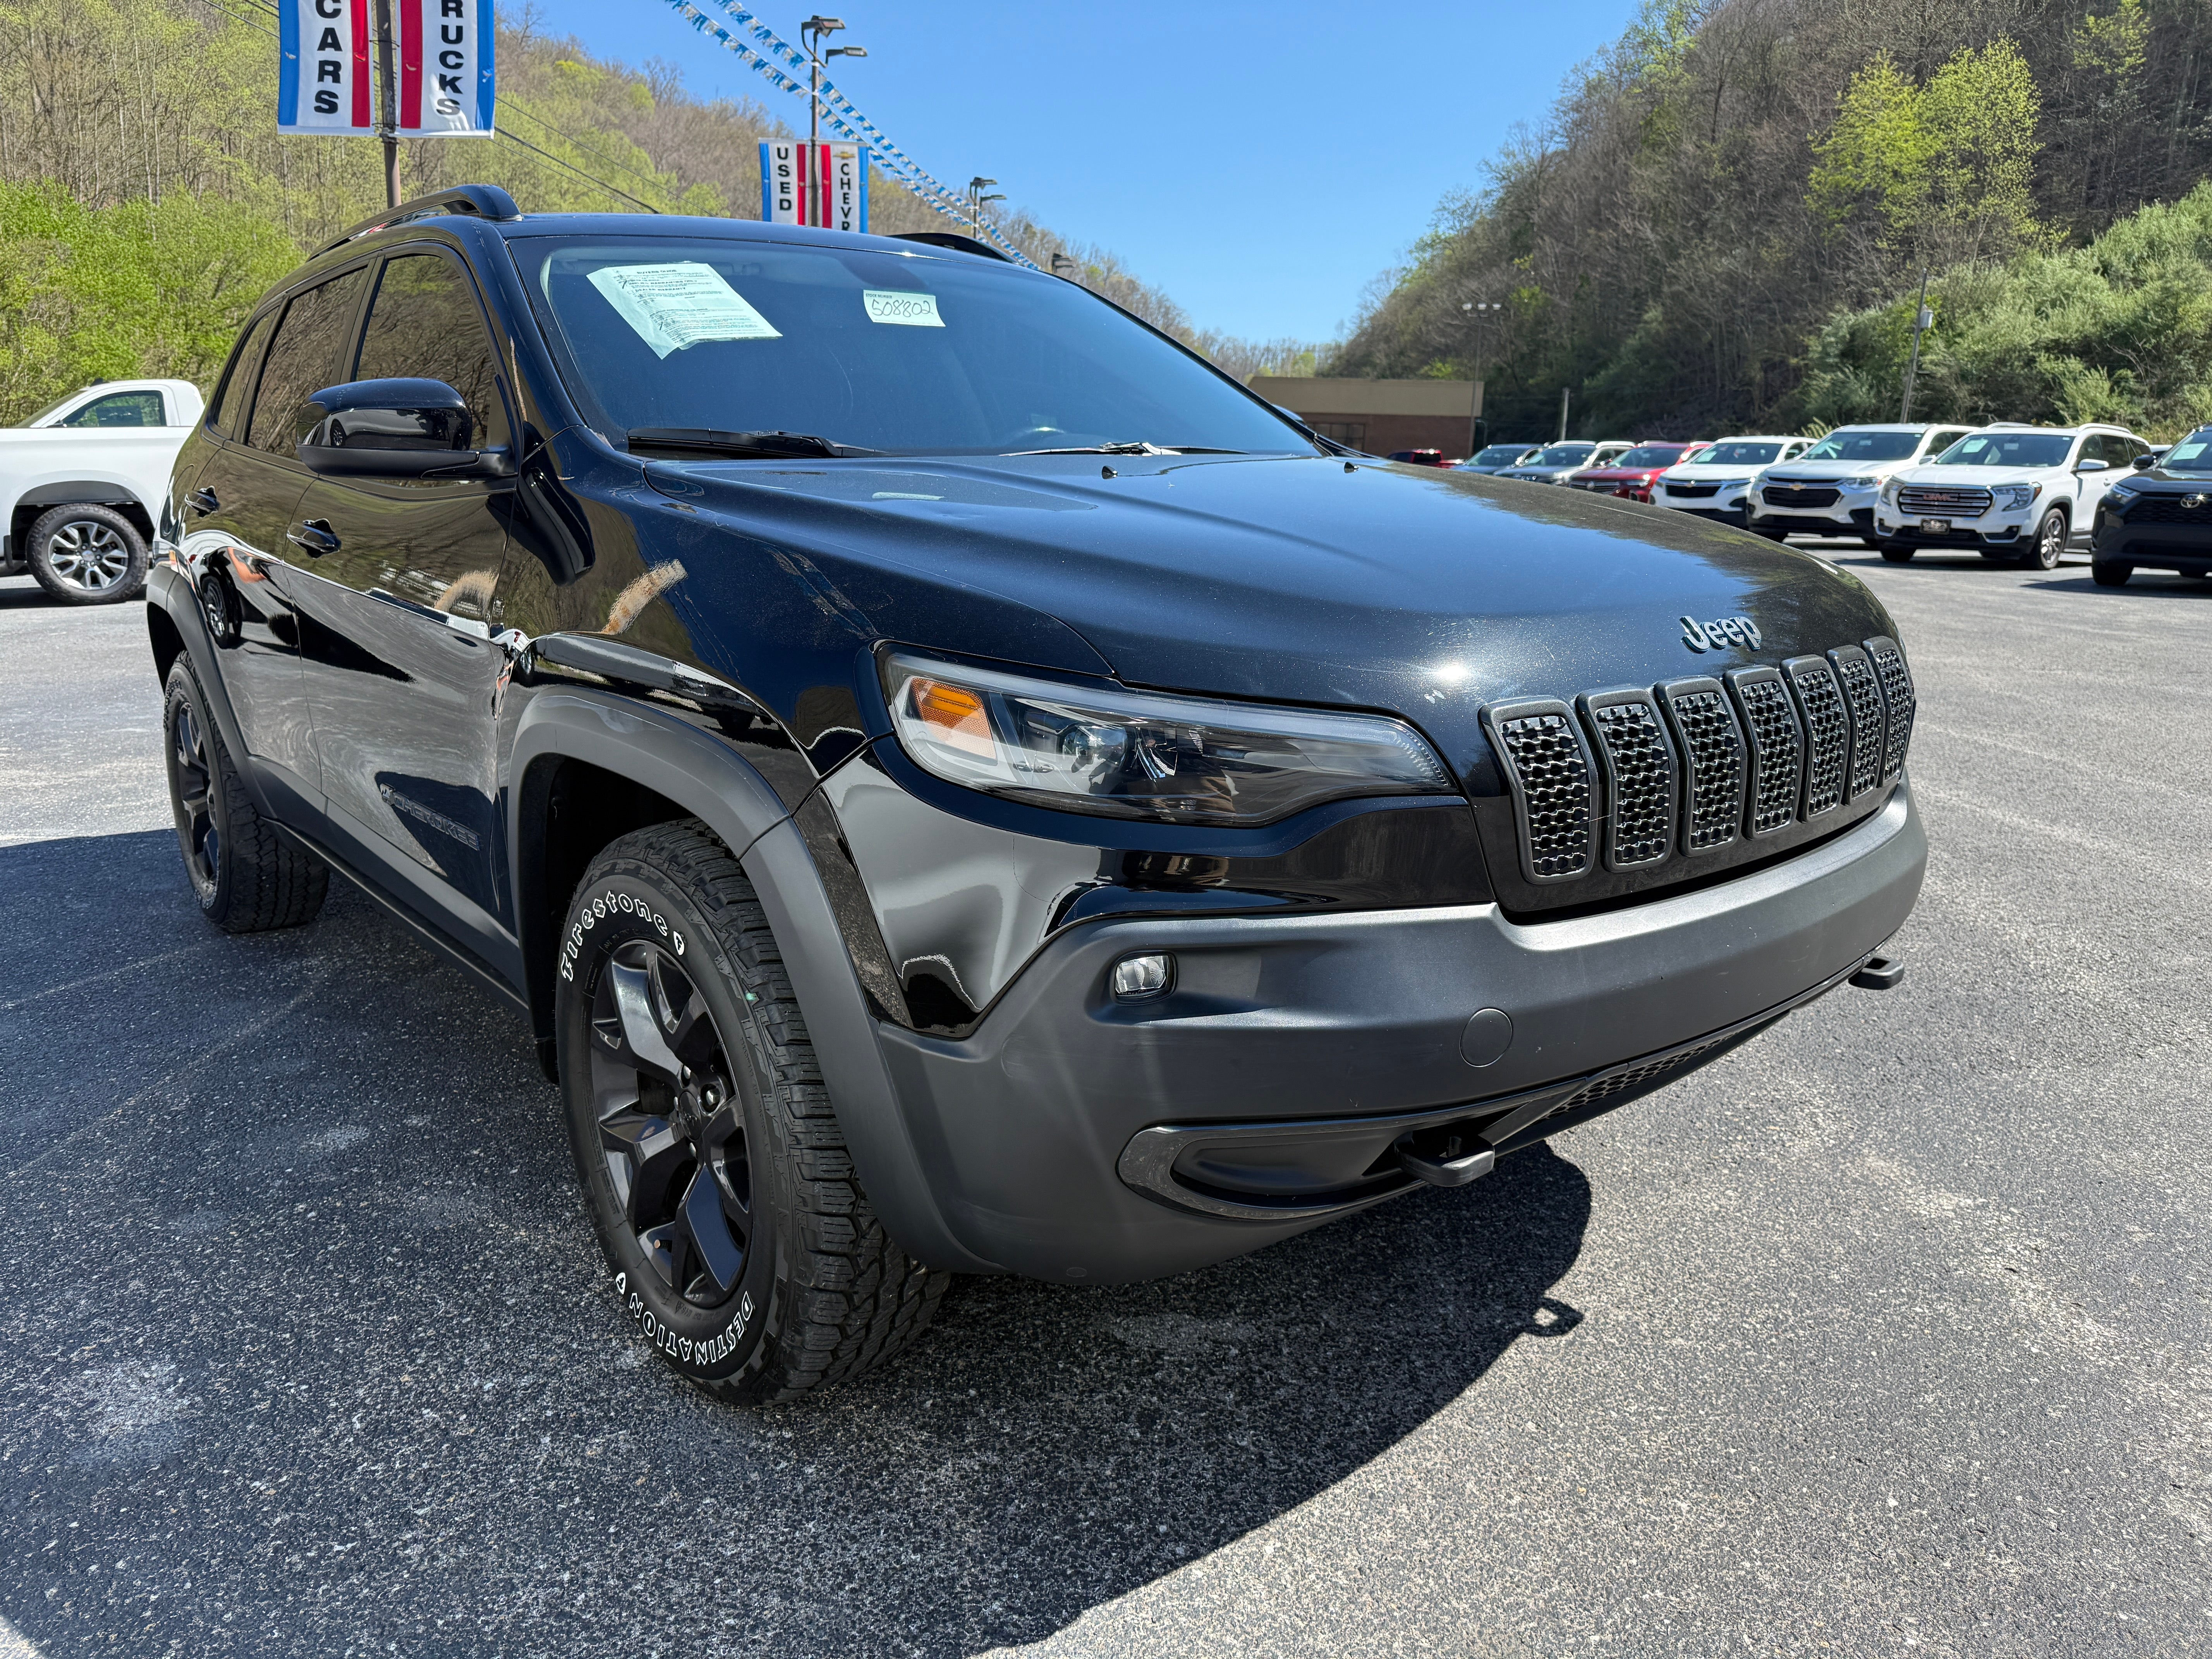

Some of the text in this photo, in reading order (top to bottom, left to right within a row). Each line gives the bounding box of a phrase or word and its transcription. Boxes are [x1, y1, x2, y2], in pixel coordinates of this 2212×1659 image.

[314, 0, 343, 114] CARS
[777, 147, 792, 211] USED
[872, 299, 934, 318] 508802
[1922, 493, 1958, 501] GMC
[1679, 615, 1762, 654] Jeep
[561, 890, 668, 982] Firestone
[629, 1291, 755, 1365] DESTINATION
